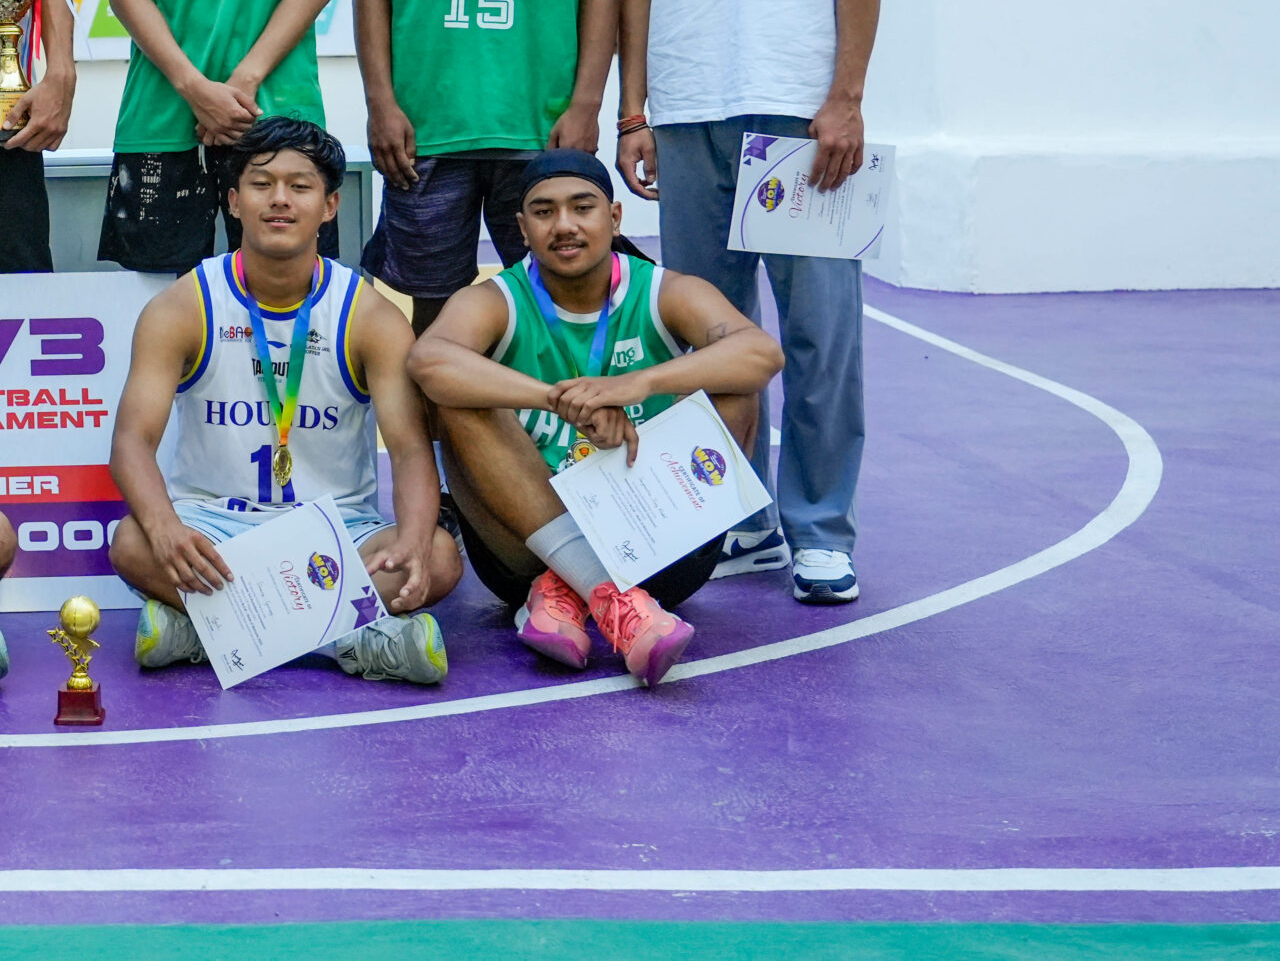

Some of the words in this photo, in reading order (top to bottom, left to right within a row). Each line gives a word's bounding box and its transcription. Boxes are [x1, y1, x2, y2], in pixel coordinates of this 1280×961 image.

[789, 173, 810, 219] Victory
[251, 358, 290, 377] TAOUT
[204, 399, 339, 431] HOUDS
[659, 451, 703, 512] Achievement
[678, 465, 700, 497] CERTIFICATE
[279, 560, 305, 611] Victory
